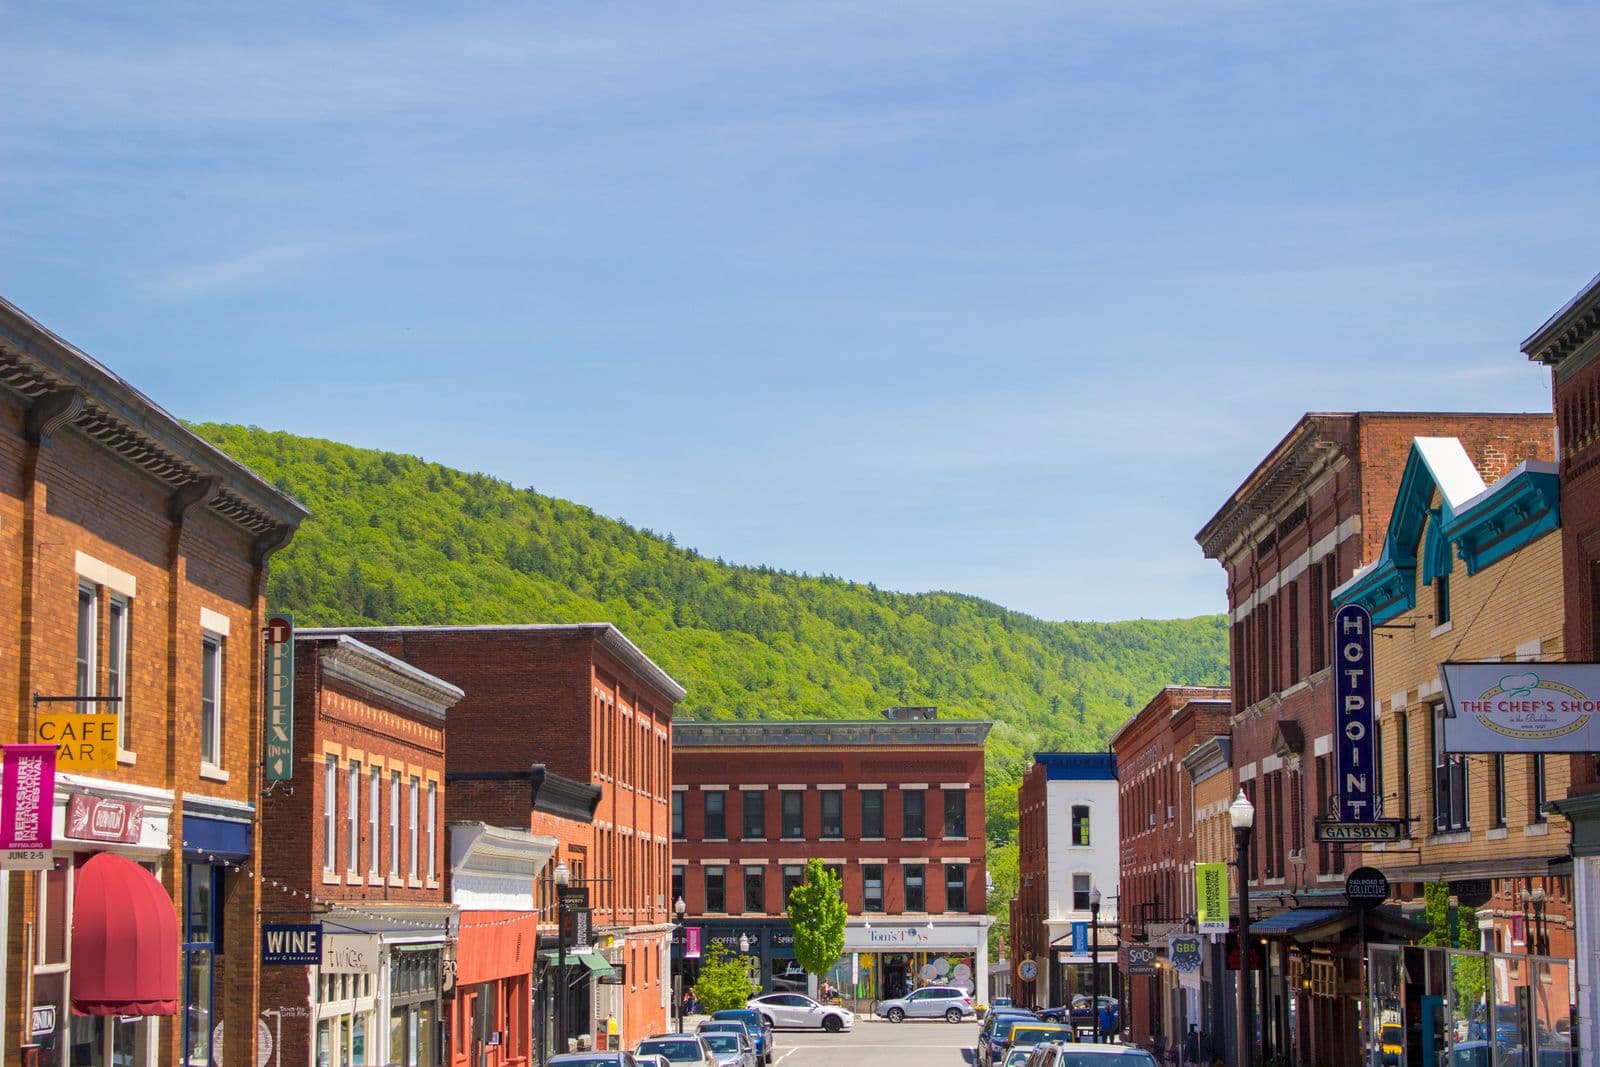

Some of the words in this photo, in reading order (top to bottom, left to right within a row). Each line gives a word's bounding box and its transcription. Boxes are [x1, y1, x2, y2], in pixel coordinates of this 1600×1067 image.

[270, 626, 290, 742] TRIPLEX
[1461, 701, 1491, 712] THE
[1498, 700, 1554, 712] CHEF'S
[1343, 616, 1366, 820] HOTPOINT
[39, 721, 115, 741] CAFE
[59, 743, 95, 761] AR
[31, 755, 42, 810] FESTIVAL
[14, 756, 28, 842] BERKSHIRE
[22, 755, 35, 841] INTERNATIONAL
[30, 813, 39, 841] FILM
[1326, 827, 1389, 838] GATSBYS
[8, 851, 28, 860] JUNE
[30, 851, 44, 860] 2-5
[1349, 885, 1385, 894] COLLECTIVE
[267, 931, 316, 953] WINE
[868, 930, 897, 941] Tom's
[1129, 949, 1154, 963] SoCo
